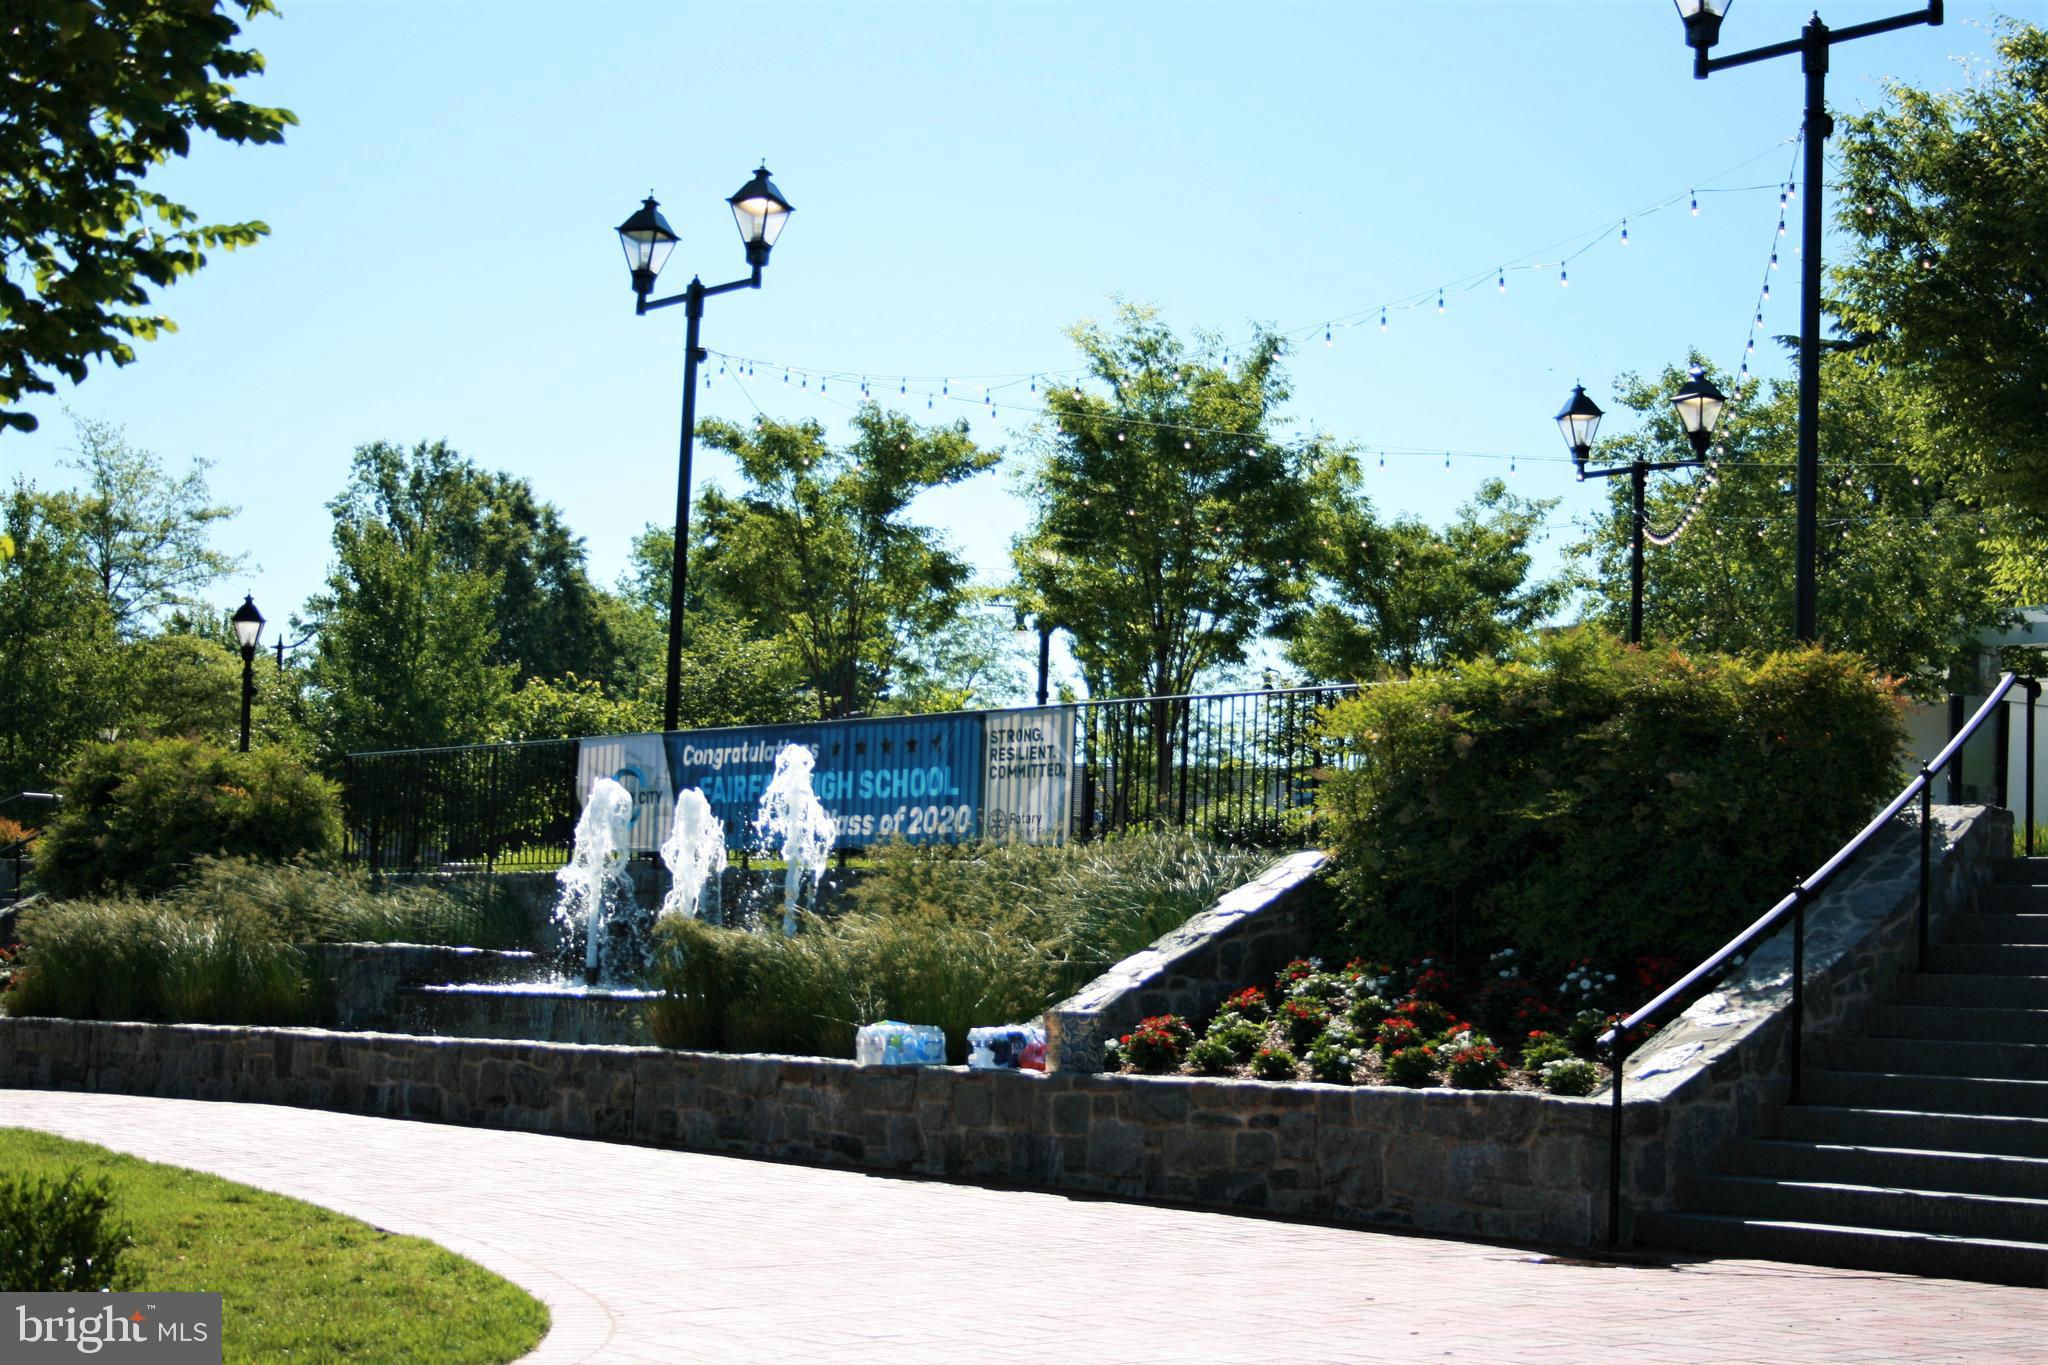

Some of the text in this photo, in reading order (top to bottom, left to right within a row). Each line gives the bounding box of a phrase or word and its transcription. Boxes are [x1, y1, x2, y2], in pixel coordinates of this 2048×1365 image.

[990, 728, 1044, 744] STRONG.
[990, 745, 1056, 762] RESILIENT.
[990, 763, 1067, 779] COMMITTED.
[814, 770, 853, 800] IGH
[858, 766, 959, 799] SCHOOL
[639, 790, 663, 804] CITY
[879, 805, 906, 836] of
[907, 804, 972, 834] 2020
[1009, 812, 1042, 829] Rotary
